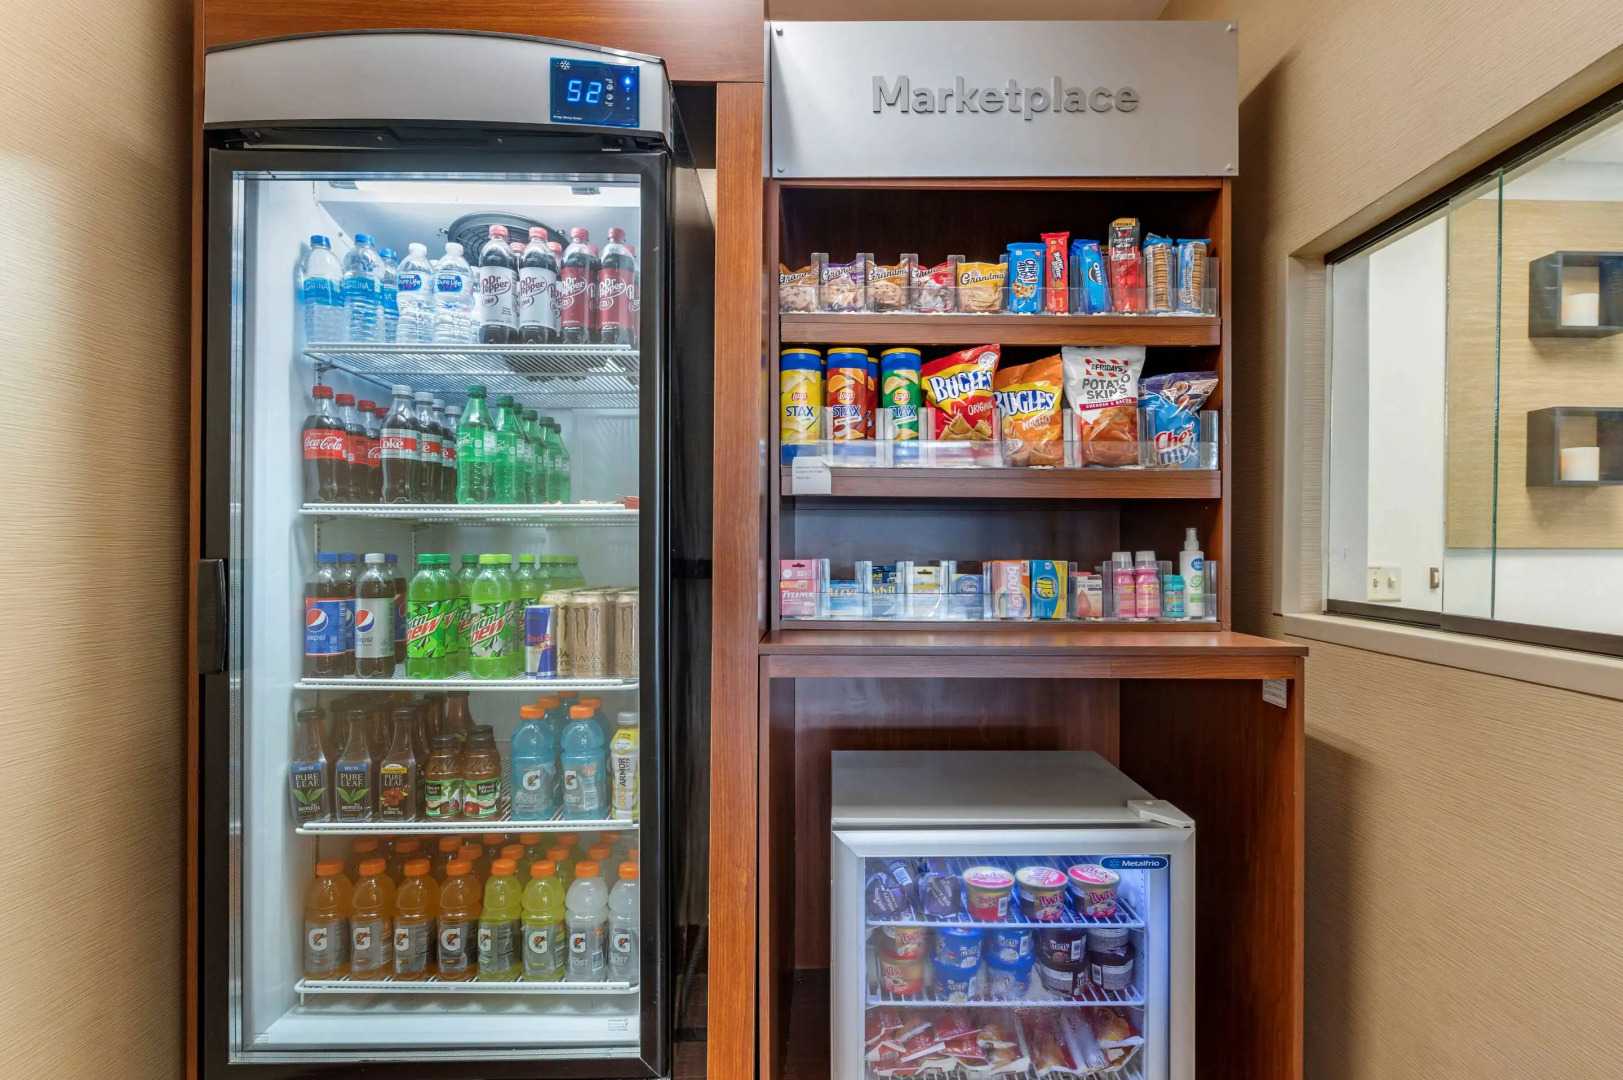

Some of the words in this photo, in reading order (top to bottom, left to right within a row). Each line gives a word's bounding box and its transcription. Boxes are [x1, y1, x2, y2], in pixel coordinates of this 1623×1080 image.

[566, 79, 602, 104] 52
[872, 75, 1140, 121] Marketplace
[1025, 258, 1037, 281] Chips
[481, 279, 510, 295] Pepper
[489, 275, 501, 286] Dr
[520, 279, 546, 296] Pepper
[526, 276, 537, 286] Dr
[562, 280, 586, 297] Pepper
[566, 276, 577, 286] Dr
[605, 277, 616, 287] Dr
[600, 280, 625, 298] Pepper
[1095, 364, 1123, 372] FRIDAYS
[1082, 373, 1131, 391] POTATO
[792, 392, 808, 400] Lay's
[838, 392, 855, 400] Lay's
[893, 392, 910, 400] Lay's
[1086, 384, 1128, 400] SKINS
[785, 406, 814, 417] STAX
[833, 405, 861, 417] STAX
[889, 405, 916, 417] STAX
[993, 390, 1055, 420] BUGLES
[304, 436, 343, 451] Coca-Cola
[296, 773, 319, 782] PURE
[340, 773, 363, 781] PURE
[1040, 894, 1064, 906] Twix
[1090, 891, 1115, 904] Twix
[308, 928, 328, 951] G
[352, 927, 371, 950] G
[394, 928, 410, 950] G
[441, 928, 461, 951] G
[478, 928, 492, 951] G
[528, 930, 548, 954] G
[569, 933, 586, 953] G
[613, 933, 631, 953] G
